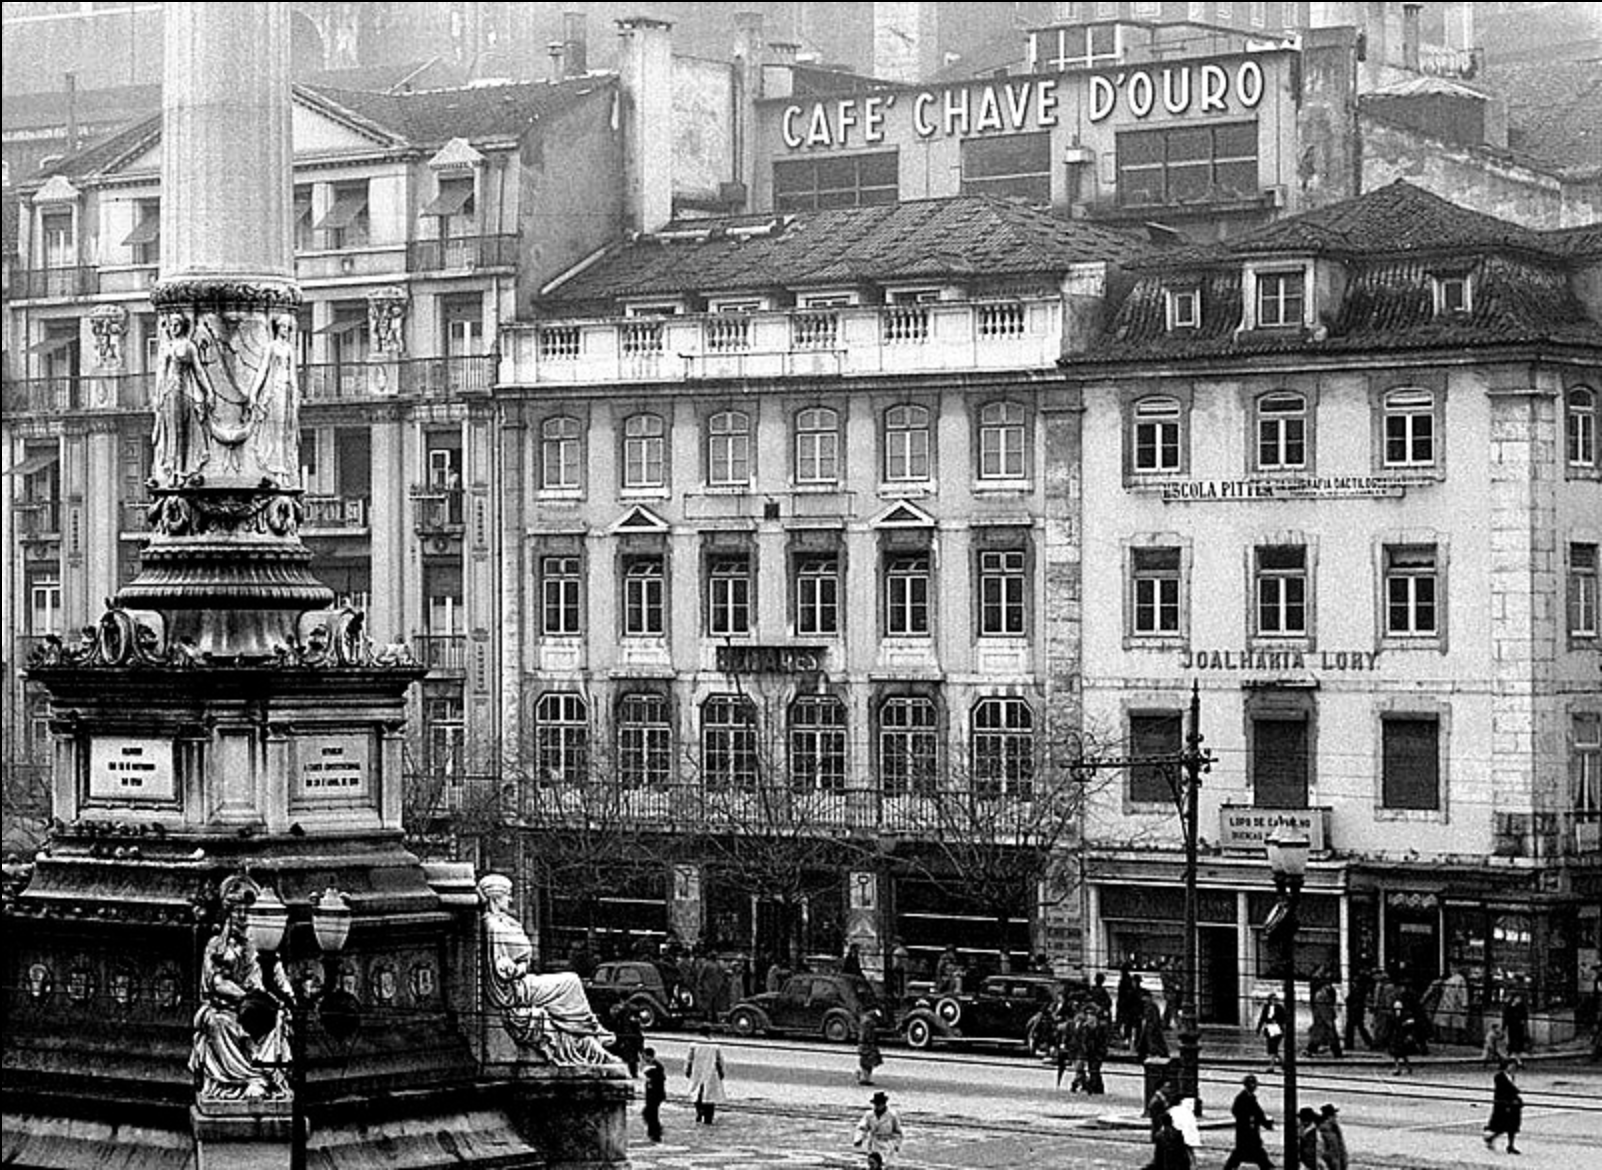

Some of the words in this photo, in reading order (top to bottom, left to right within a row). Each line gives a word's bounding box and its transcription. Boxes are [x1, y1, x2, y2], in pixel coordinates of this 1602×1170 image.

[913, 78, 1058, 136] CHAVE
[1089, 61, 1263, 121] D'OURO
[1163, 482, 1216, 499] ESCOLA
[1182, 650, 1306, 670] JOALHARIA
[1253, 817, 1264, 827] DE
